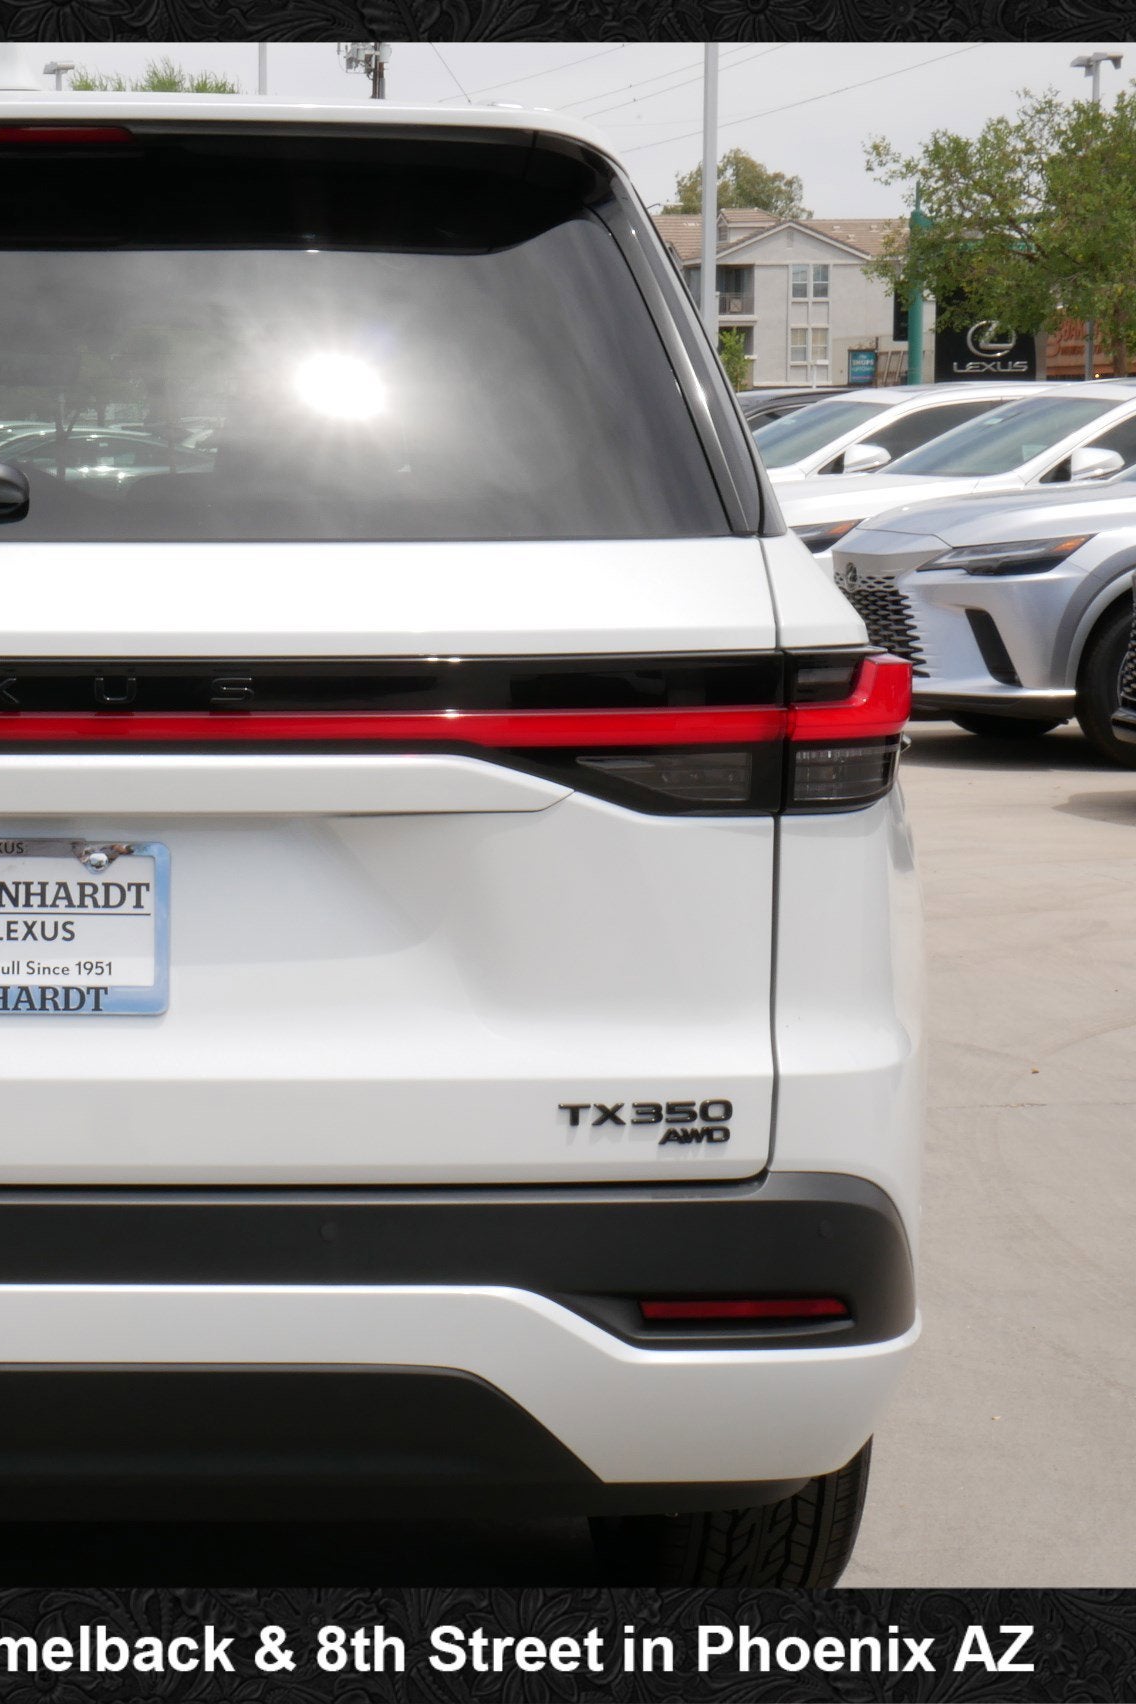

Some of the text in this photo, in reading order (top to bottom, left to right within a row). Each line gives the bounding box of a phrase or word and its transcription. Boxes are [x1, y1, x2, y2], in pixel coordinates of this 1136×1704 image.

[952, 360, 1029, 373] LEXUS
[26, 960, 71, 976] Since
[75, 960, 113, 976] 1951
[658, 1125, 731, 1145] AWD
